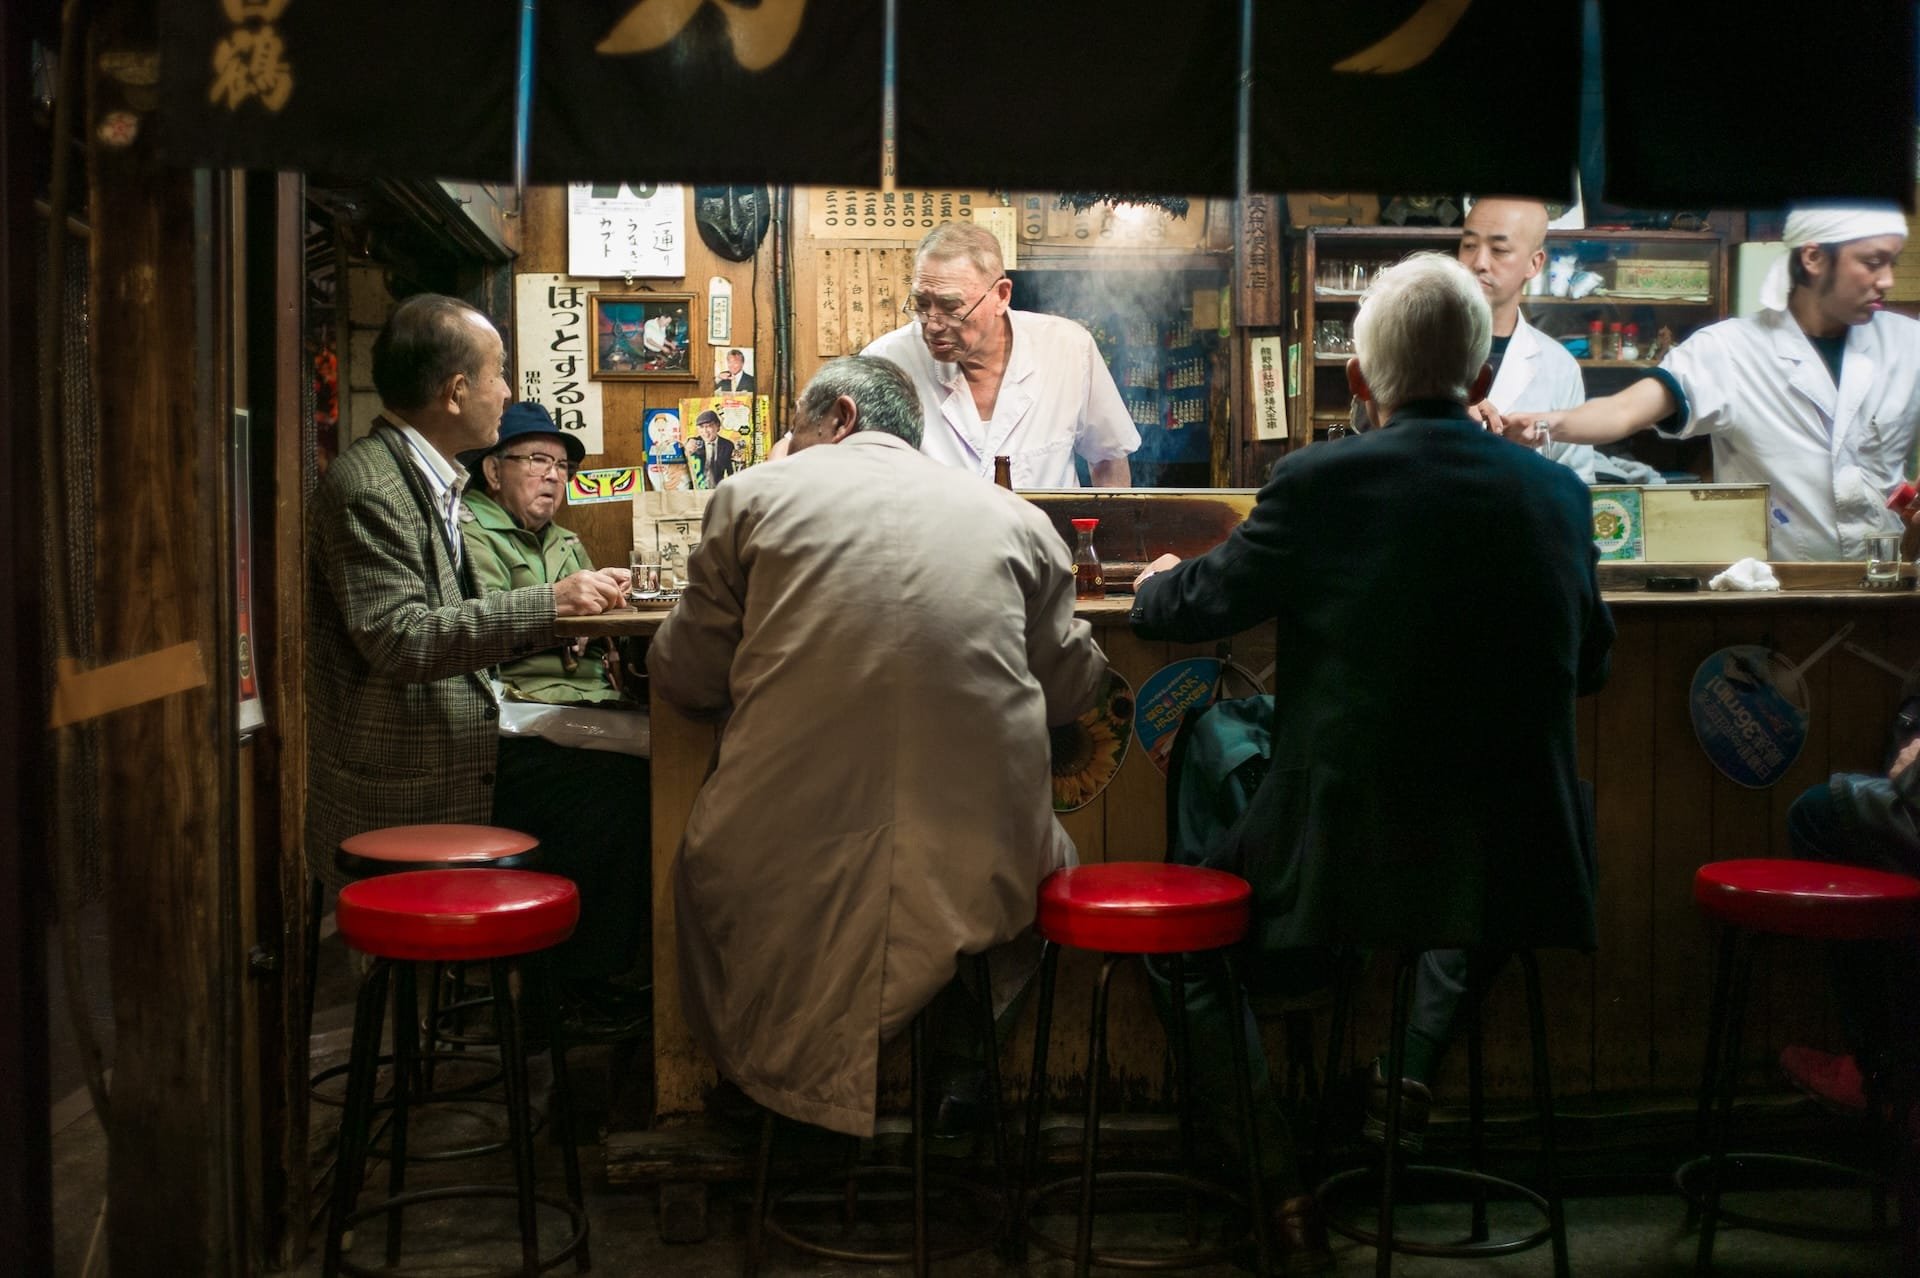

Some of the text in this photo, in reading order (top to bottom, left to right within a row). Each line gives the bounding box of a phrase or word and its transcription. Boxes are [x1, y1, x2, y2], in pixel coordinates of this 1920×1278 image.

[600, 217, 615, 258] カブト
[626, 218, 642, 264] うなぎ
[548, 286, 587, 430] ほっとするね
